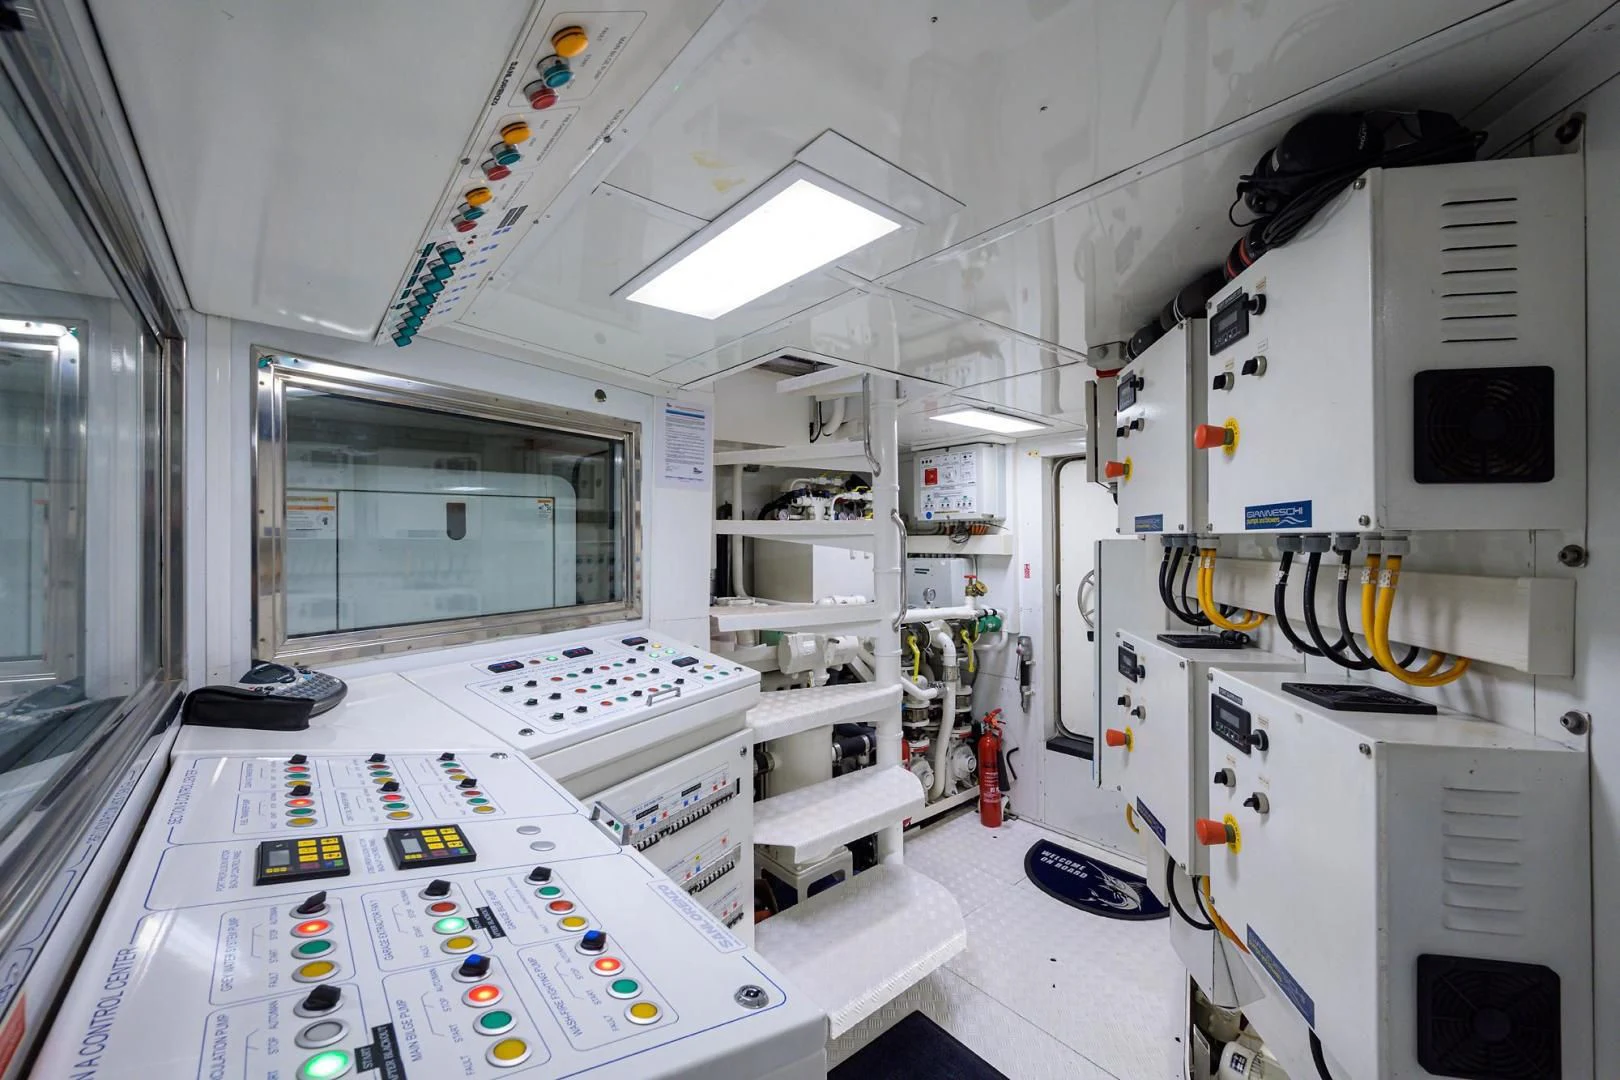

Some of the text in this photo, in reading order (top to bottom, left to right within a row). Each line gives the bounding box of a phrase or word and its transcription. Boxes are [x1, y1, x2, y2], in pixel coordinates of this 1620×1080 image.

[1040, 857, 1088, 879] ON BOARD
[1041, 850, 1086, 871] WELCOME
[657, 884, 734, 949] SANLORENZO
[104, 948, 137, 990] CENTER
[79, 990, 124, 1056] CONTROL
[215, 1014, 229, 1036] PUMP
[396, 999, 423, 1062] MAIN BILGE PUMP
[449, 1024, 464, 1043] START
[603, 1015, 618, 1032] FAULT
[267, 1037, 279, 1055] STOP
[74, 1056, 102, 1067] A
[361, 1047, 374, 1070] START
[460, 1055, 475, 1076] FAULT
